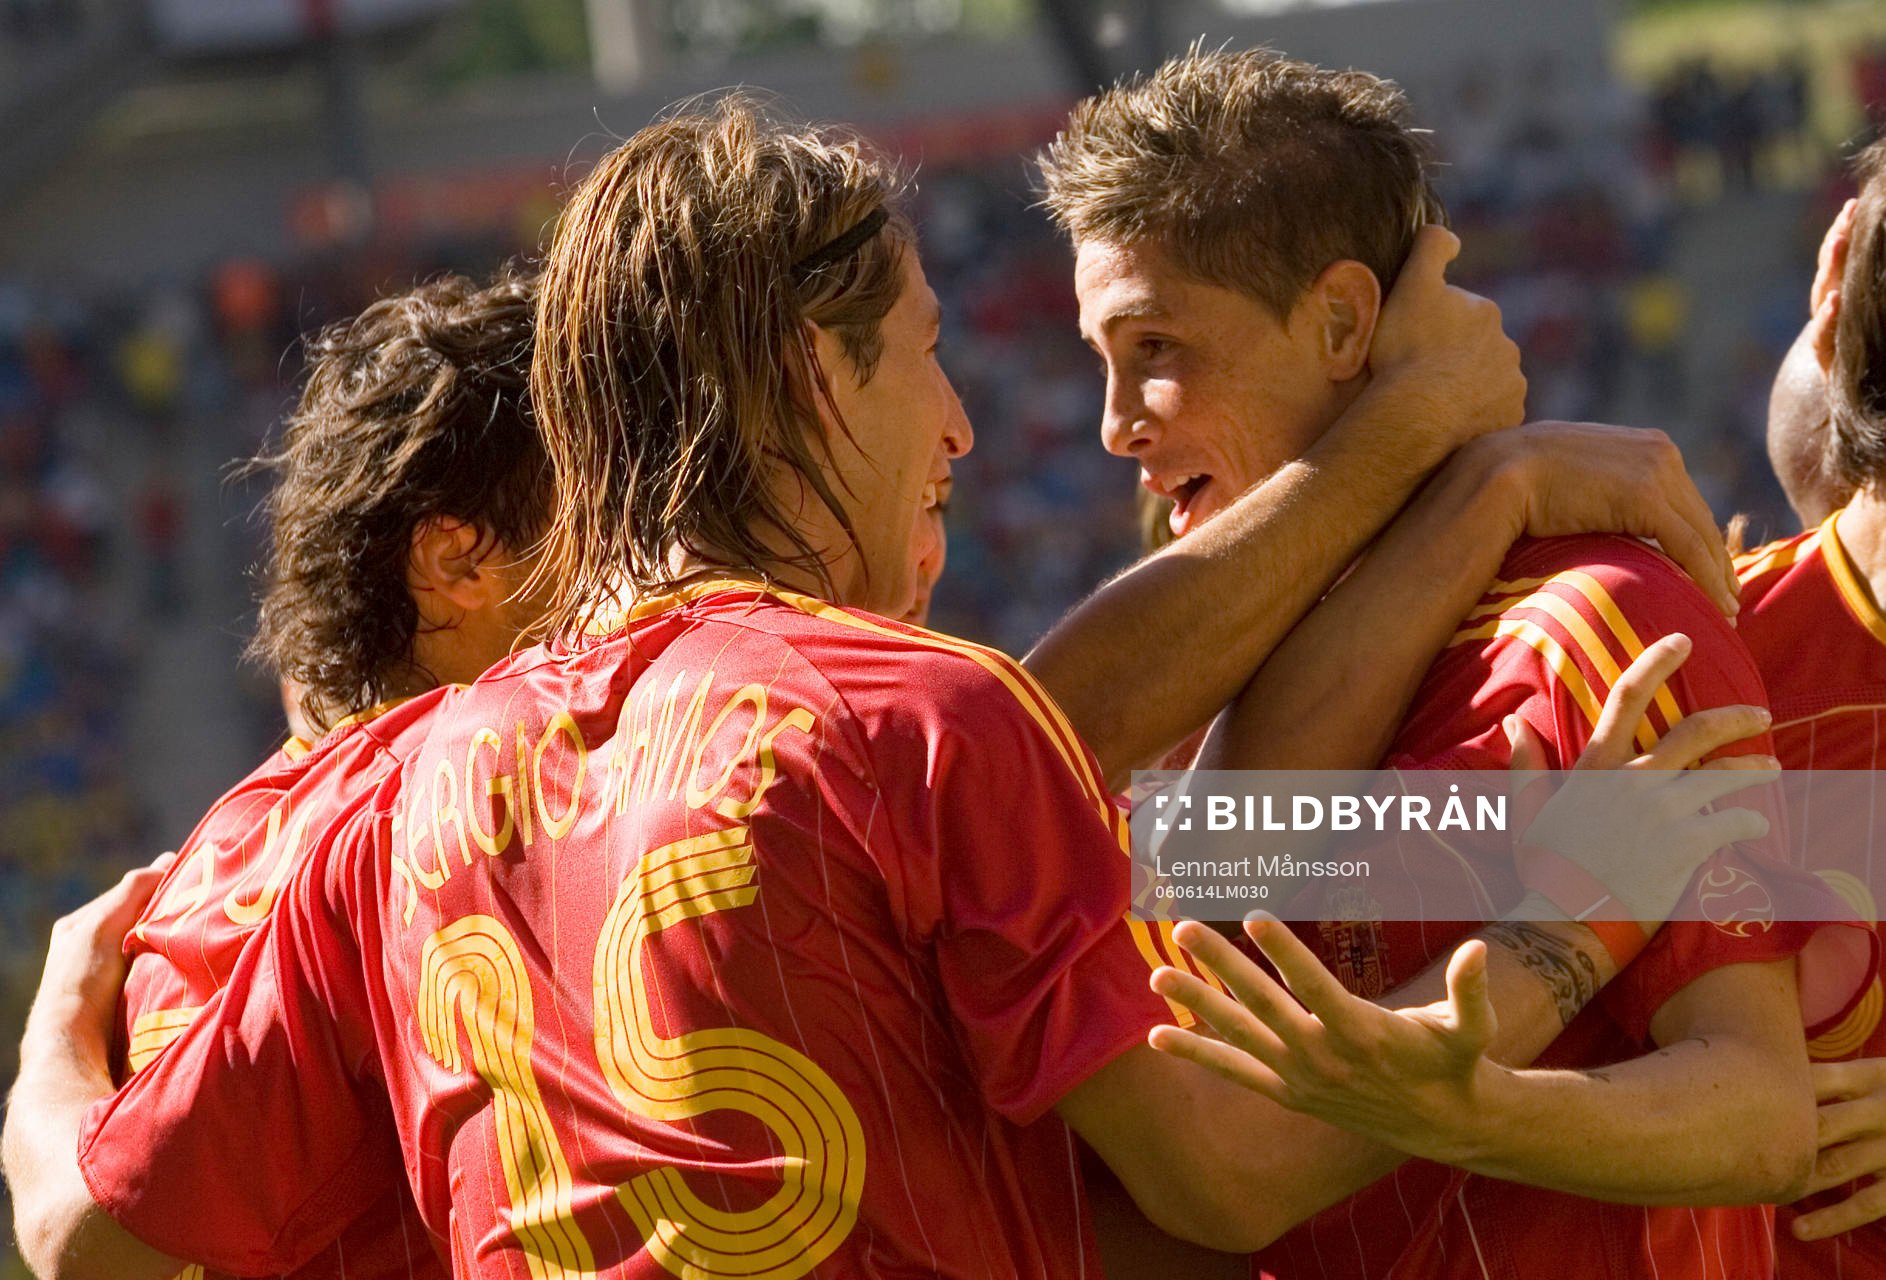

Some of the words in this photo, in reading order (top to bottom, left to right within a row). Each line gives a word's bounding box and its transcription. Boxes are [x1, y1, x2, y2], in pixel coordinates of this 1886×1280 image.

[391, 711, 587, 929] SERGIO
[596, 669, 816, 826] RAMOS
[417, 825, 867, 1280] 15
